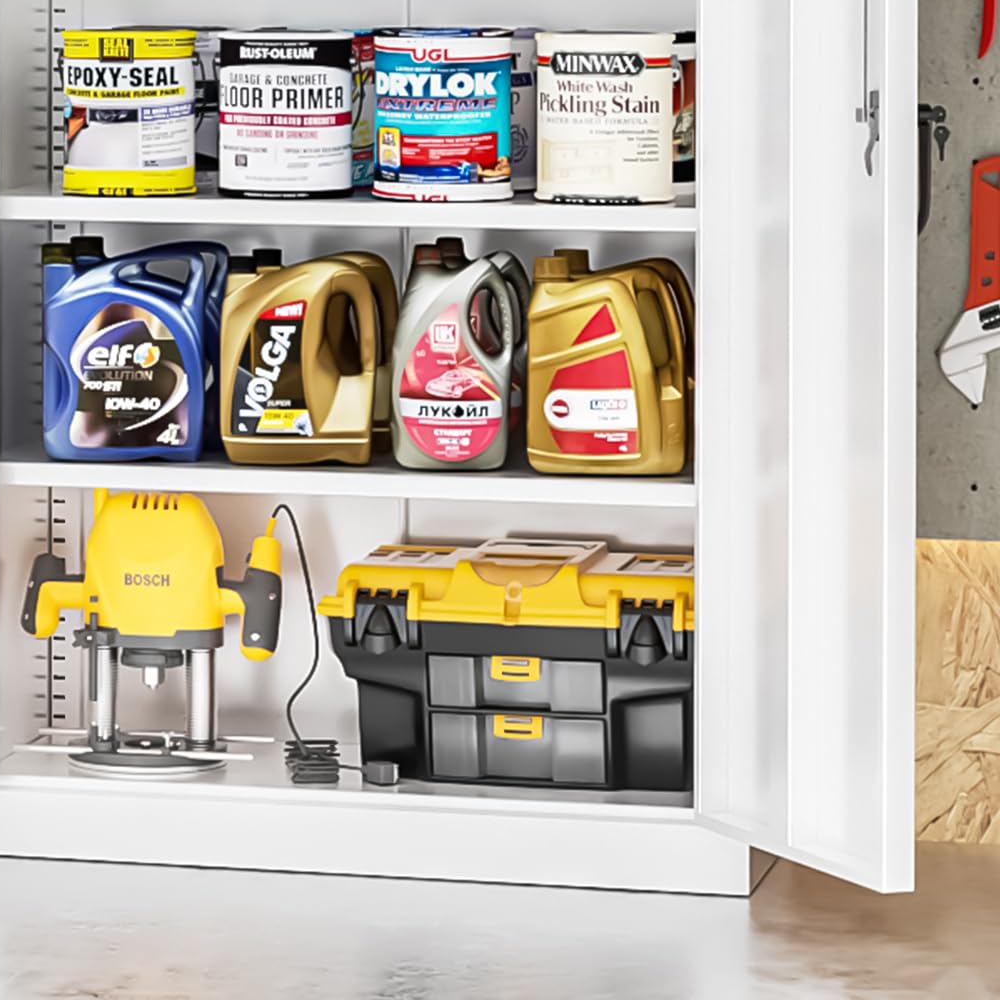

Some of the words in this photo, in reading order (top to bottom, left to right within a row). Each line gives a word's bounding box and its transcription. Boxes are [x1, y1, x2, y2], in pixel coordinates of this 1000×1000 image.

[239, 45, 315, 60] RUST-OLEUM
[412, 48, 449, 62] UGL
[556, 54, 638, 74] MINWAX
[67, 65, 180, 88] EPOXY-SEAL
[264, 74, 272, 85] &
[276, 73, 328, 86] CONCRETE
[375, 70, 498, 98] DRYLOK
[557, 80, 594, 92] White
[596, 81, 634, 93] Wash
[272, 86, 344, 110] PRIMER
[539, 91, 608, 117] Pickling
[611, 94, 661, 114] Stain
[87, 344, 135, 367] elf
[239, 326, 296, 417] VOLGA
[124, 573, 170, 587] BOSCH
